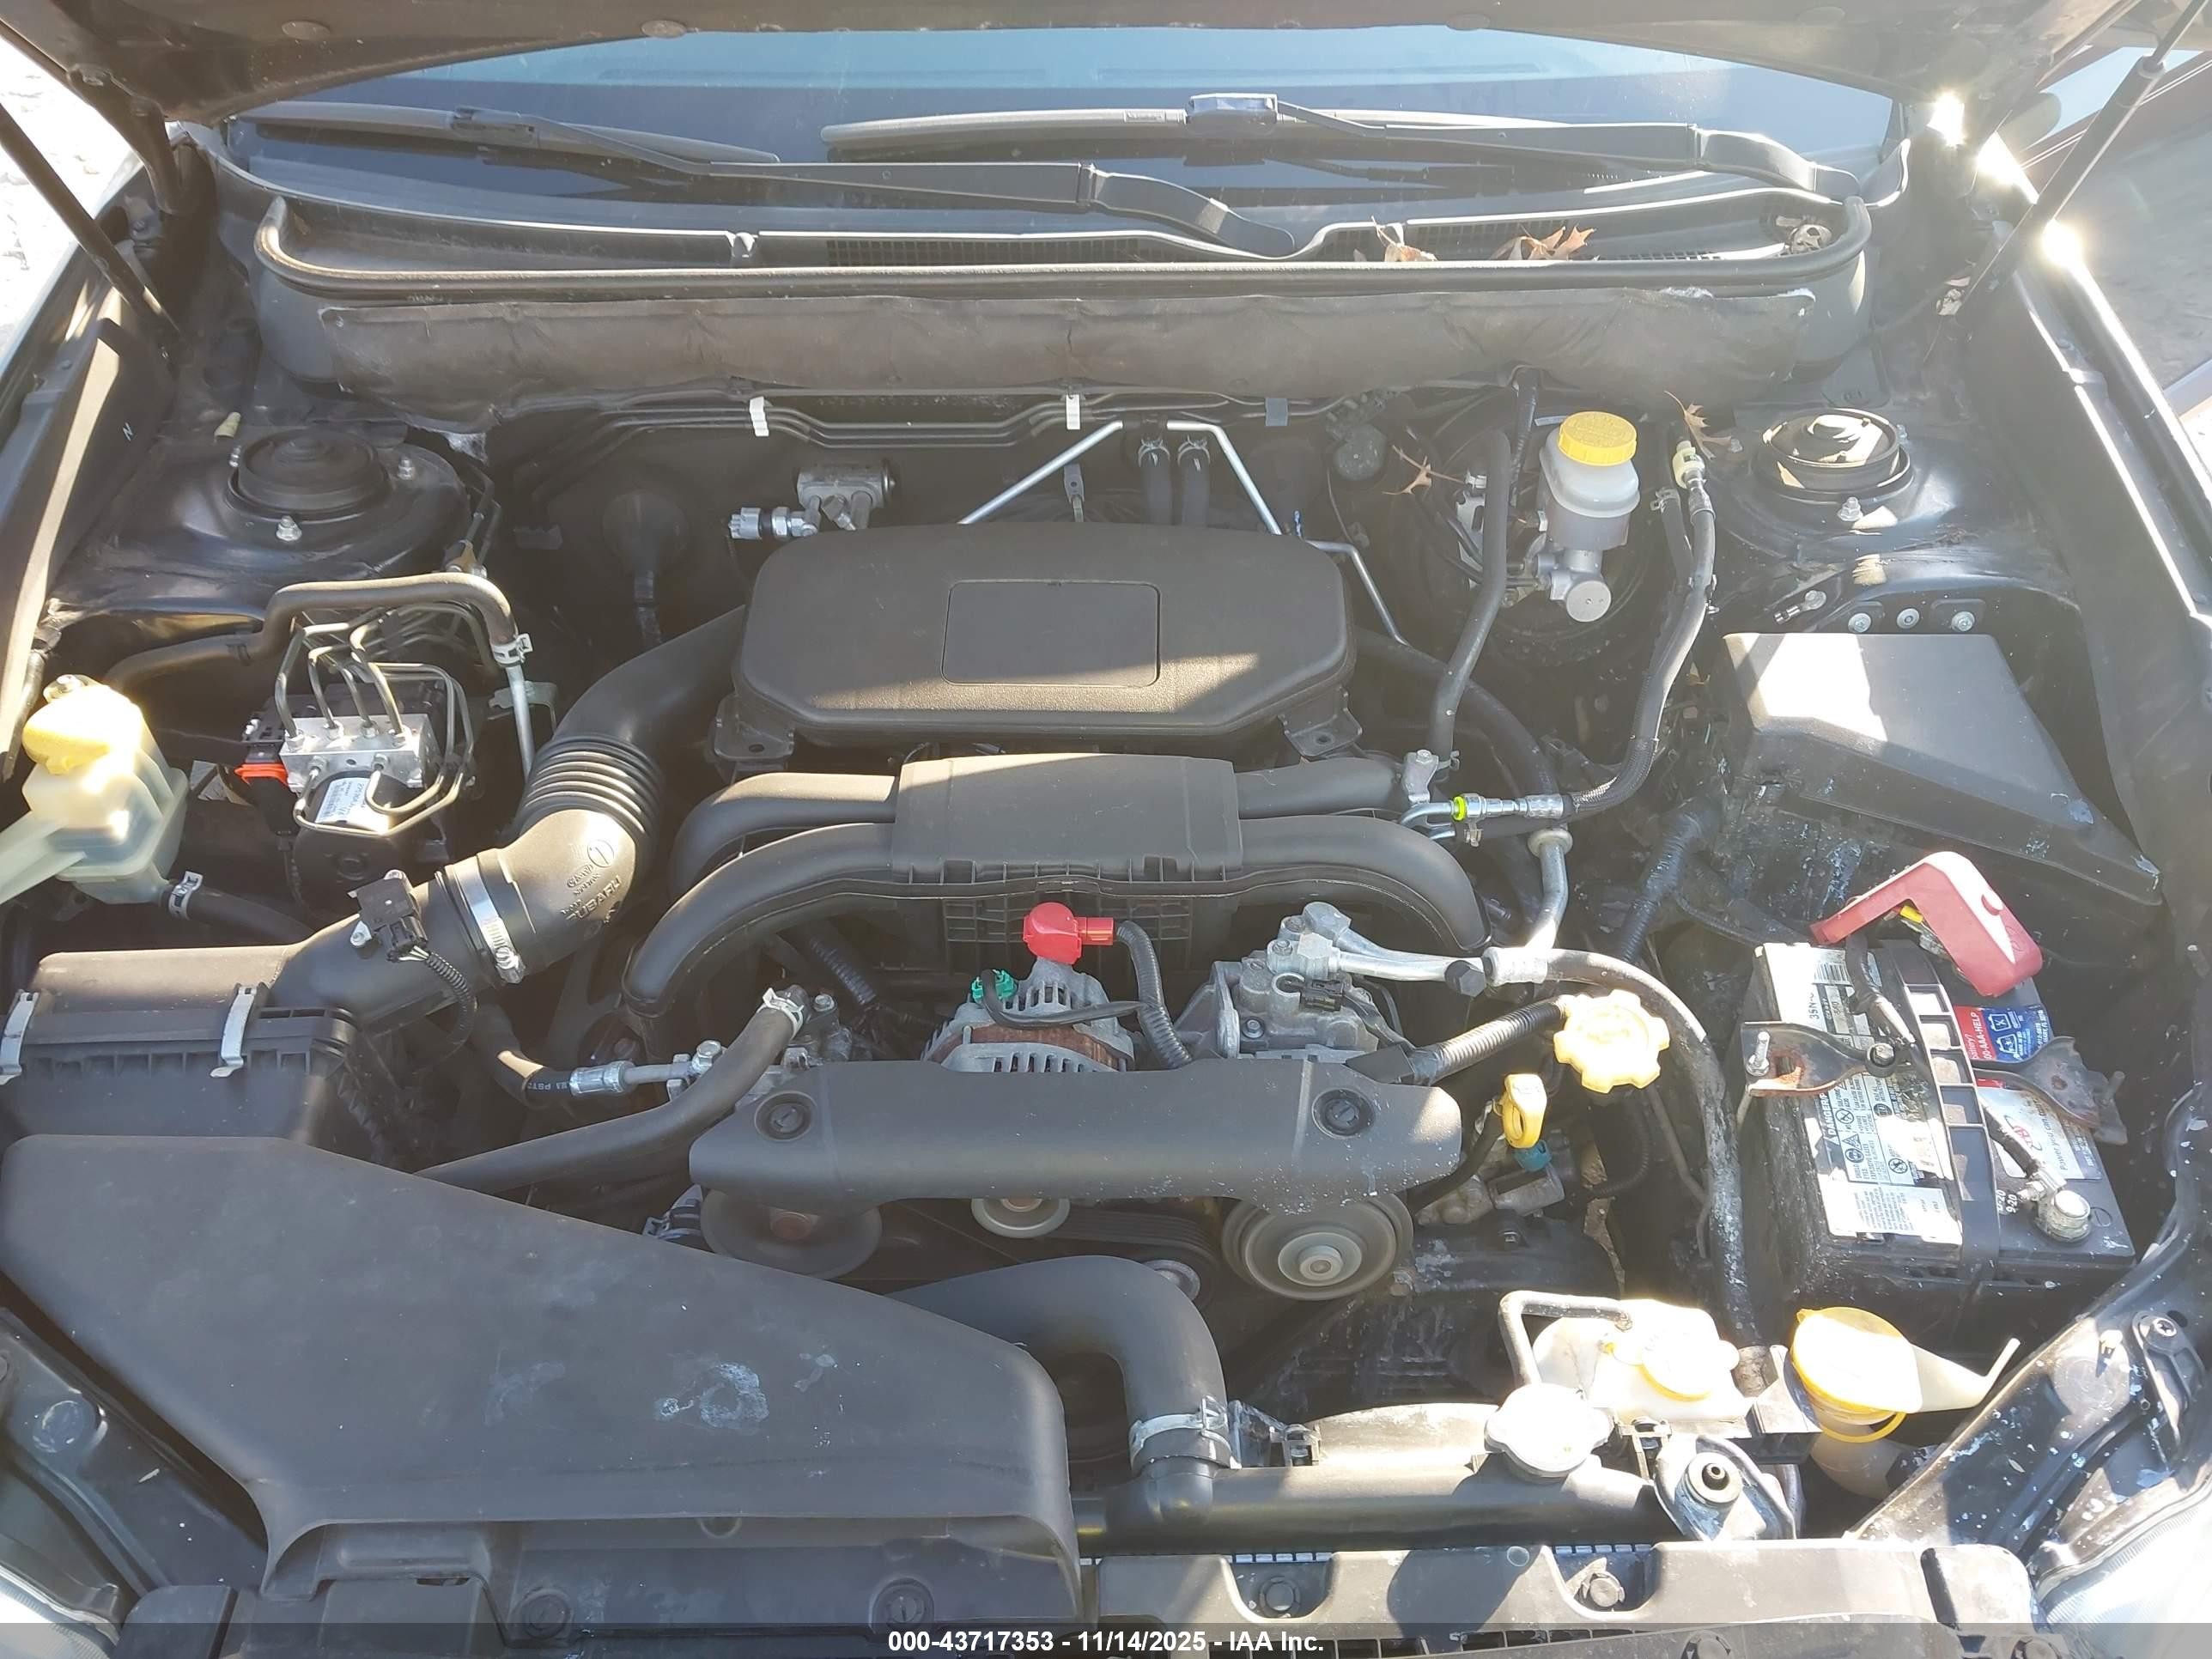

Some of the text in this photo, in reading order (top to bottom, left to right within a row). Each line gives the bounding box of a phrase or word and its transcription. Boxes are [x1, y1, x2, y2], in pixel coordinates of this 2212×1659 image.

[2041, 1118, 2051, 1131] can
[2053, 1146, 2069, 1171] Power
[2005, 1194, 2018, 1213] 9-20
